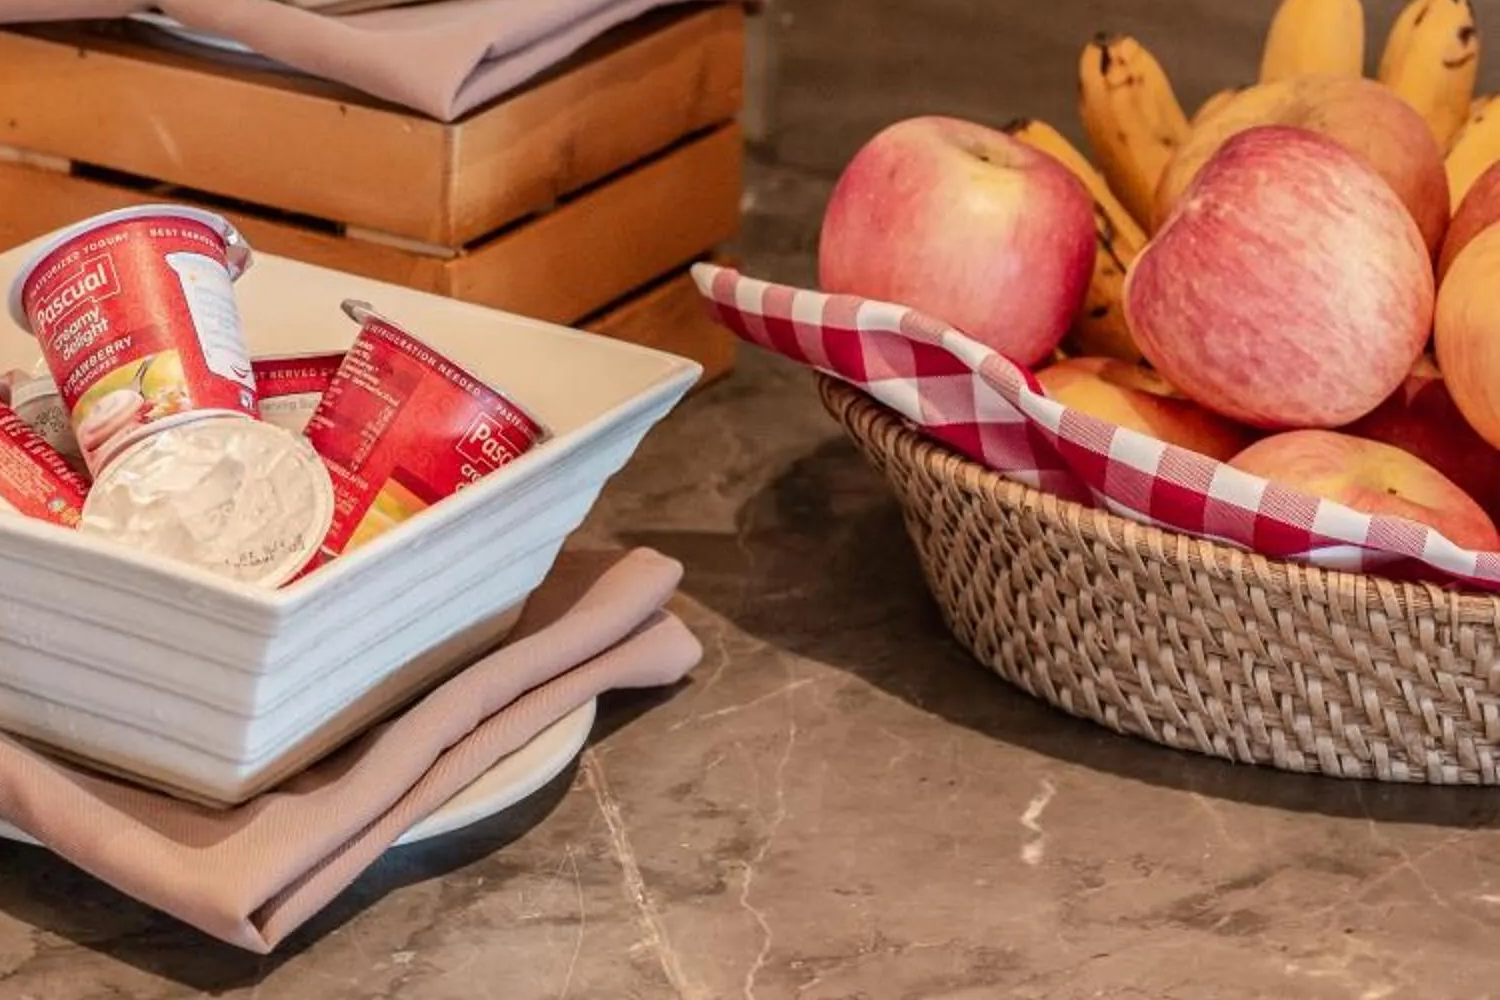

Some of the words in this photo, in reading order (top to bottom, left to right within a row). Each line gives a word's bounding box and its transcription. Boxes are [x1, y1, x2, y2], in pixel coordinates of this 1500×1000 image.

[36, 263, 108, 336] Pascual
[63, 335, 132, 396] STRAWBERRY
[437, 363, 482, 396] NEEDED
